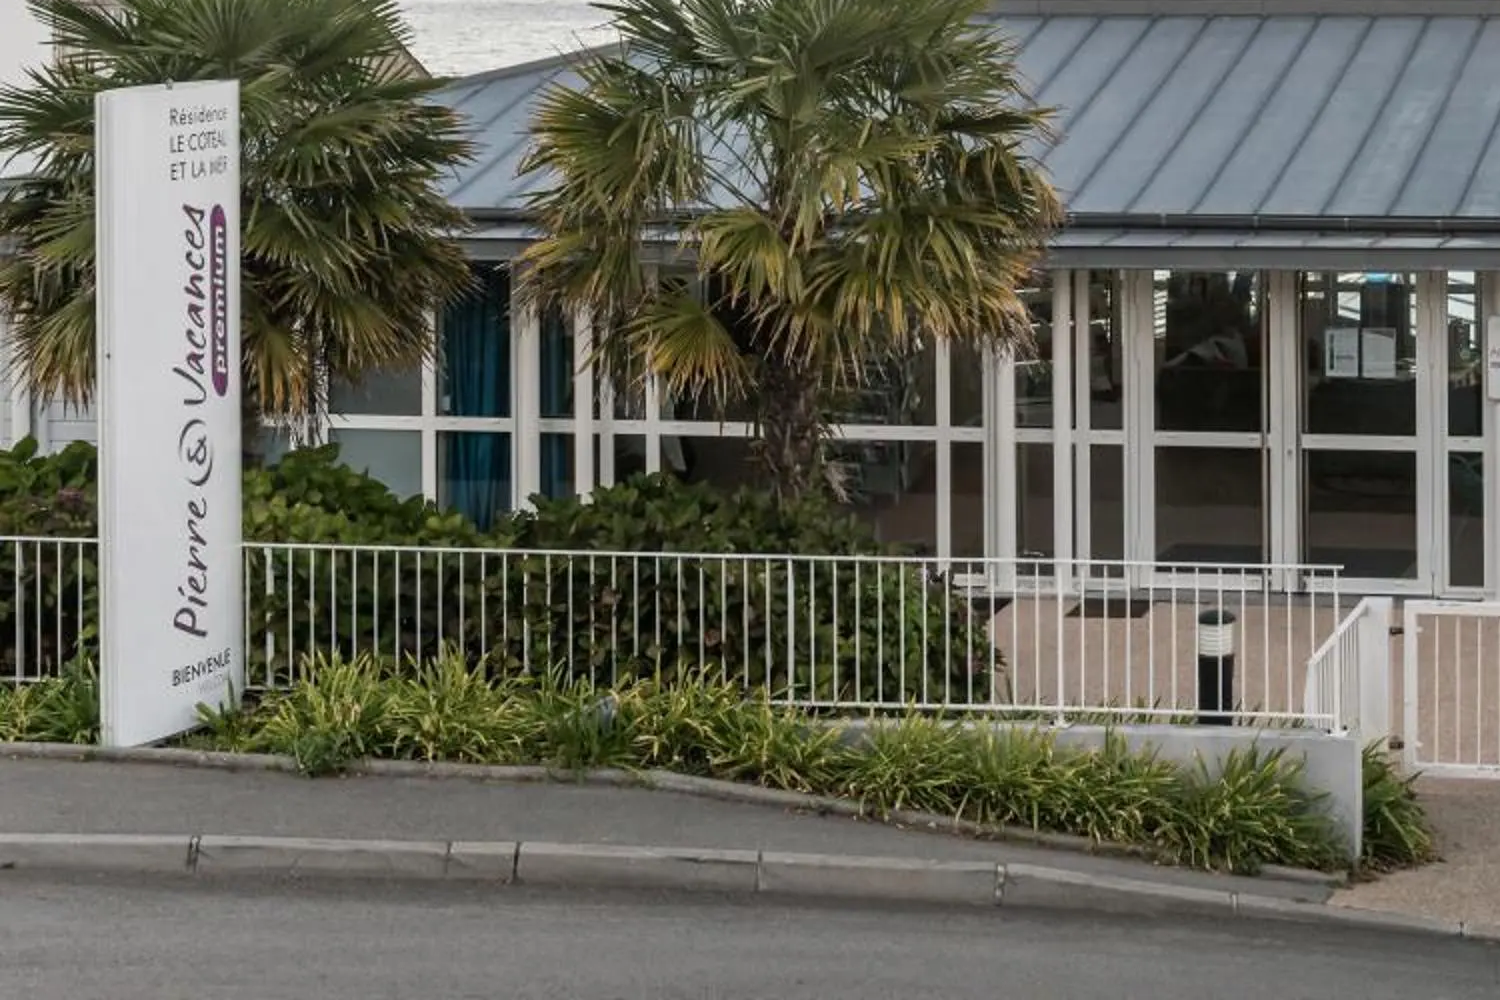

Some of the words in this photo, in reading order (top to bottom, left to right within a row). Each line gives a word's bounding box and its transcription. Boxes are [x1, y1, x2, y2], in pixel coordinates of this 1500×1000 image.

[169, 135, 185, 154] LE
[170, 161, 187, 181] ET
[172, 203, 207, 406] Vacances
[213, 224, 228, 376] premium
[173, 497, 208, 638] Pierre
